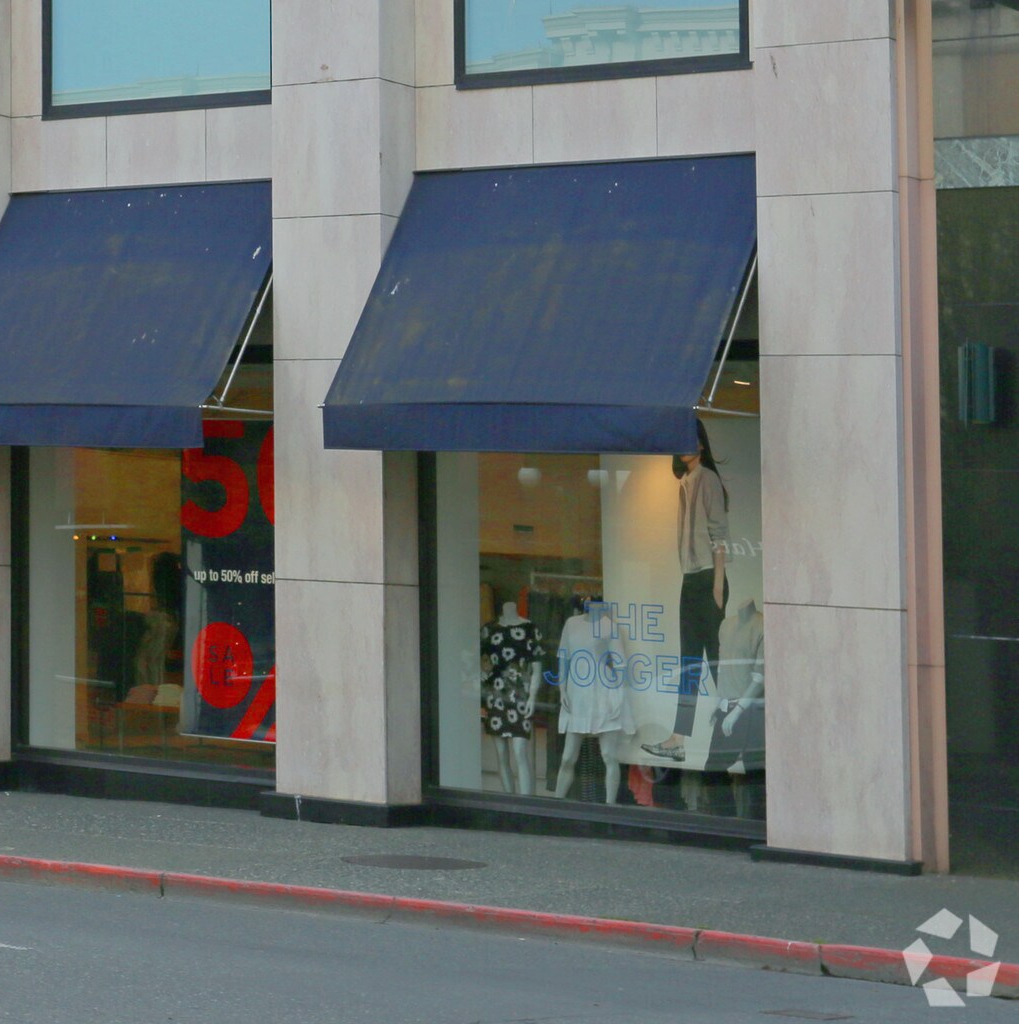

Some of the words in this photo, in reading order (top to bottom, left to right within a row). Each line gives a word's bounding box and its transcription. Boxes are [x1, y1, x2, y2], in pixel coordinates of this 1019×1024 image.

[194, 570, 207, 586] up
[209, 568, 219, 582] to
[220, 569, 243, 584] 50%
[244, 570, 259, 584] off
[583, 600, 665, 643] THE
[543, 648, 710, 697] JOGGER
